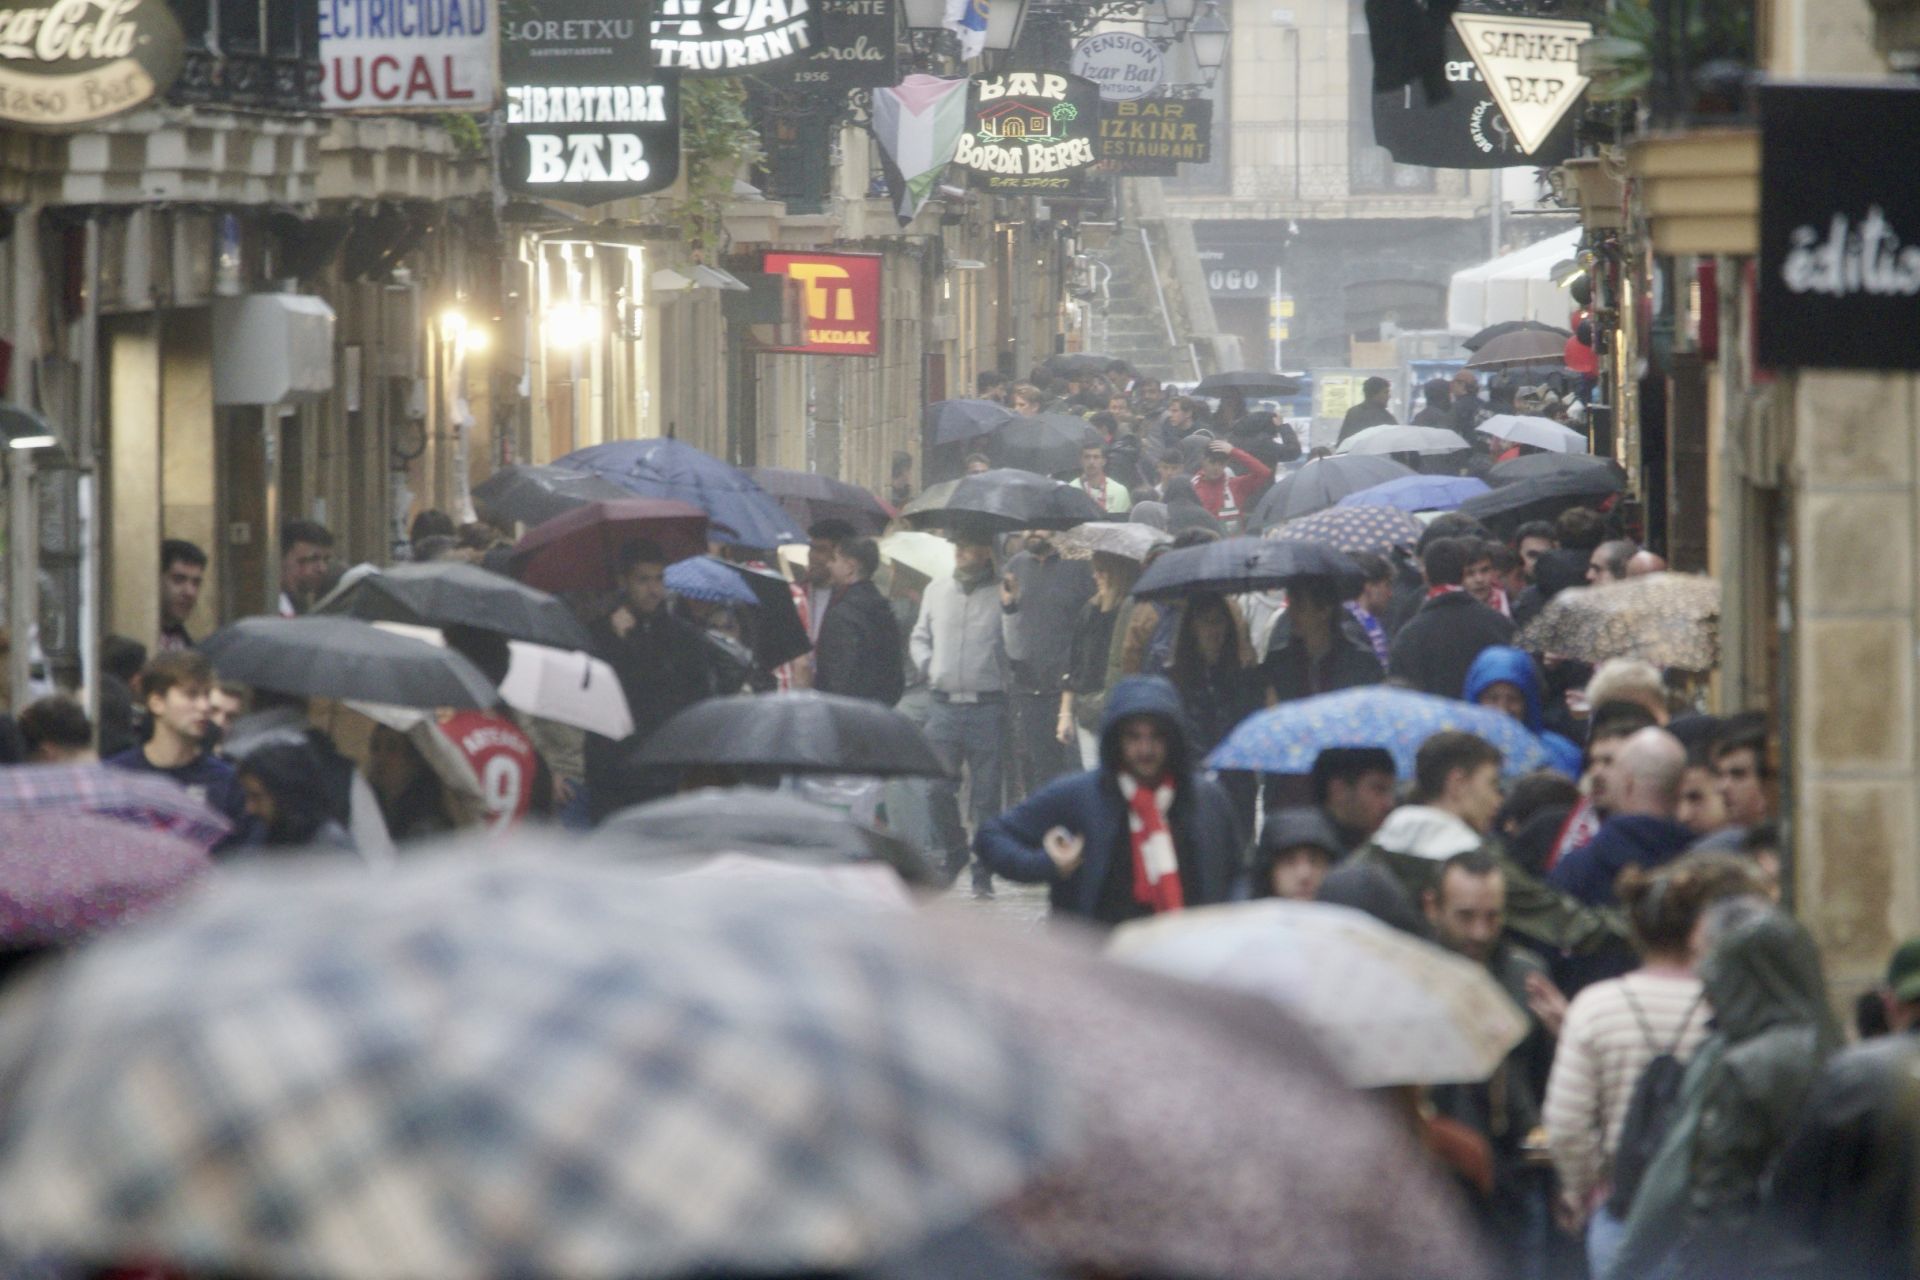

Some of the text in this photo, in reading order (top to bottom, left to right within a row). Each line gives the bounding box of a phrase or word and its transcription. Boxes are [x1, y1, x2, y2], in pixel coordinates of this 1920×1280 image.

[1083, 36, 1158, 64] PENSION
[794, 72, 830, 82] 1956
[1081, 62, 1120, 80] Izar
[977, 73, 1068, 101] BAR
[1505, 75, 1564, 104] BAR
[1118, 102, 1185, 118] BAR
[1100, 119, 1197, 142] IZKINA
[526, 133, 650, 182] BAR
[953, 132, 1023, 174] BORDA
[989, 177, 1070, 188] BAR SPORT
[485, 754, 520, 836] 9
